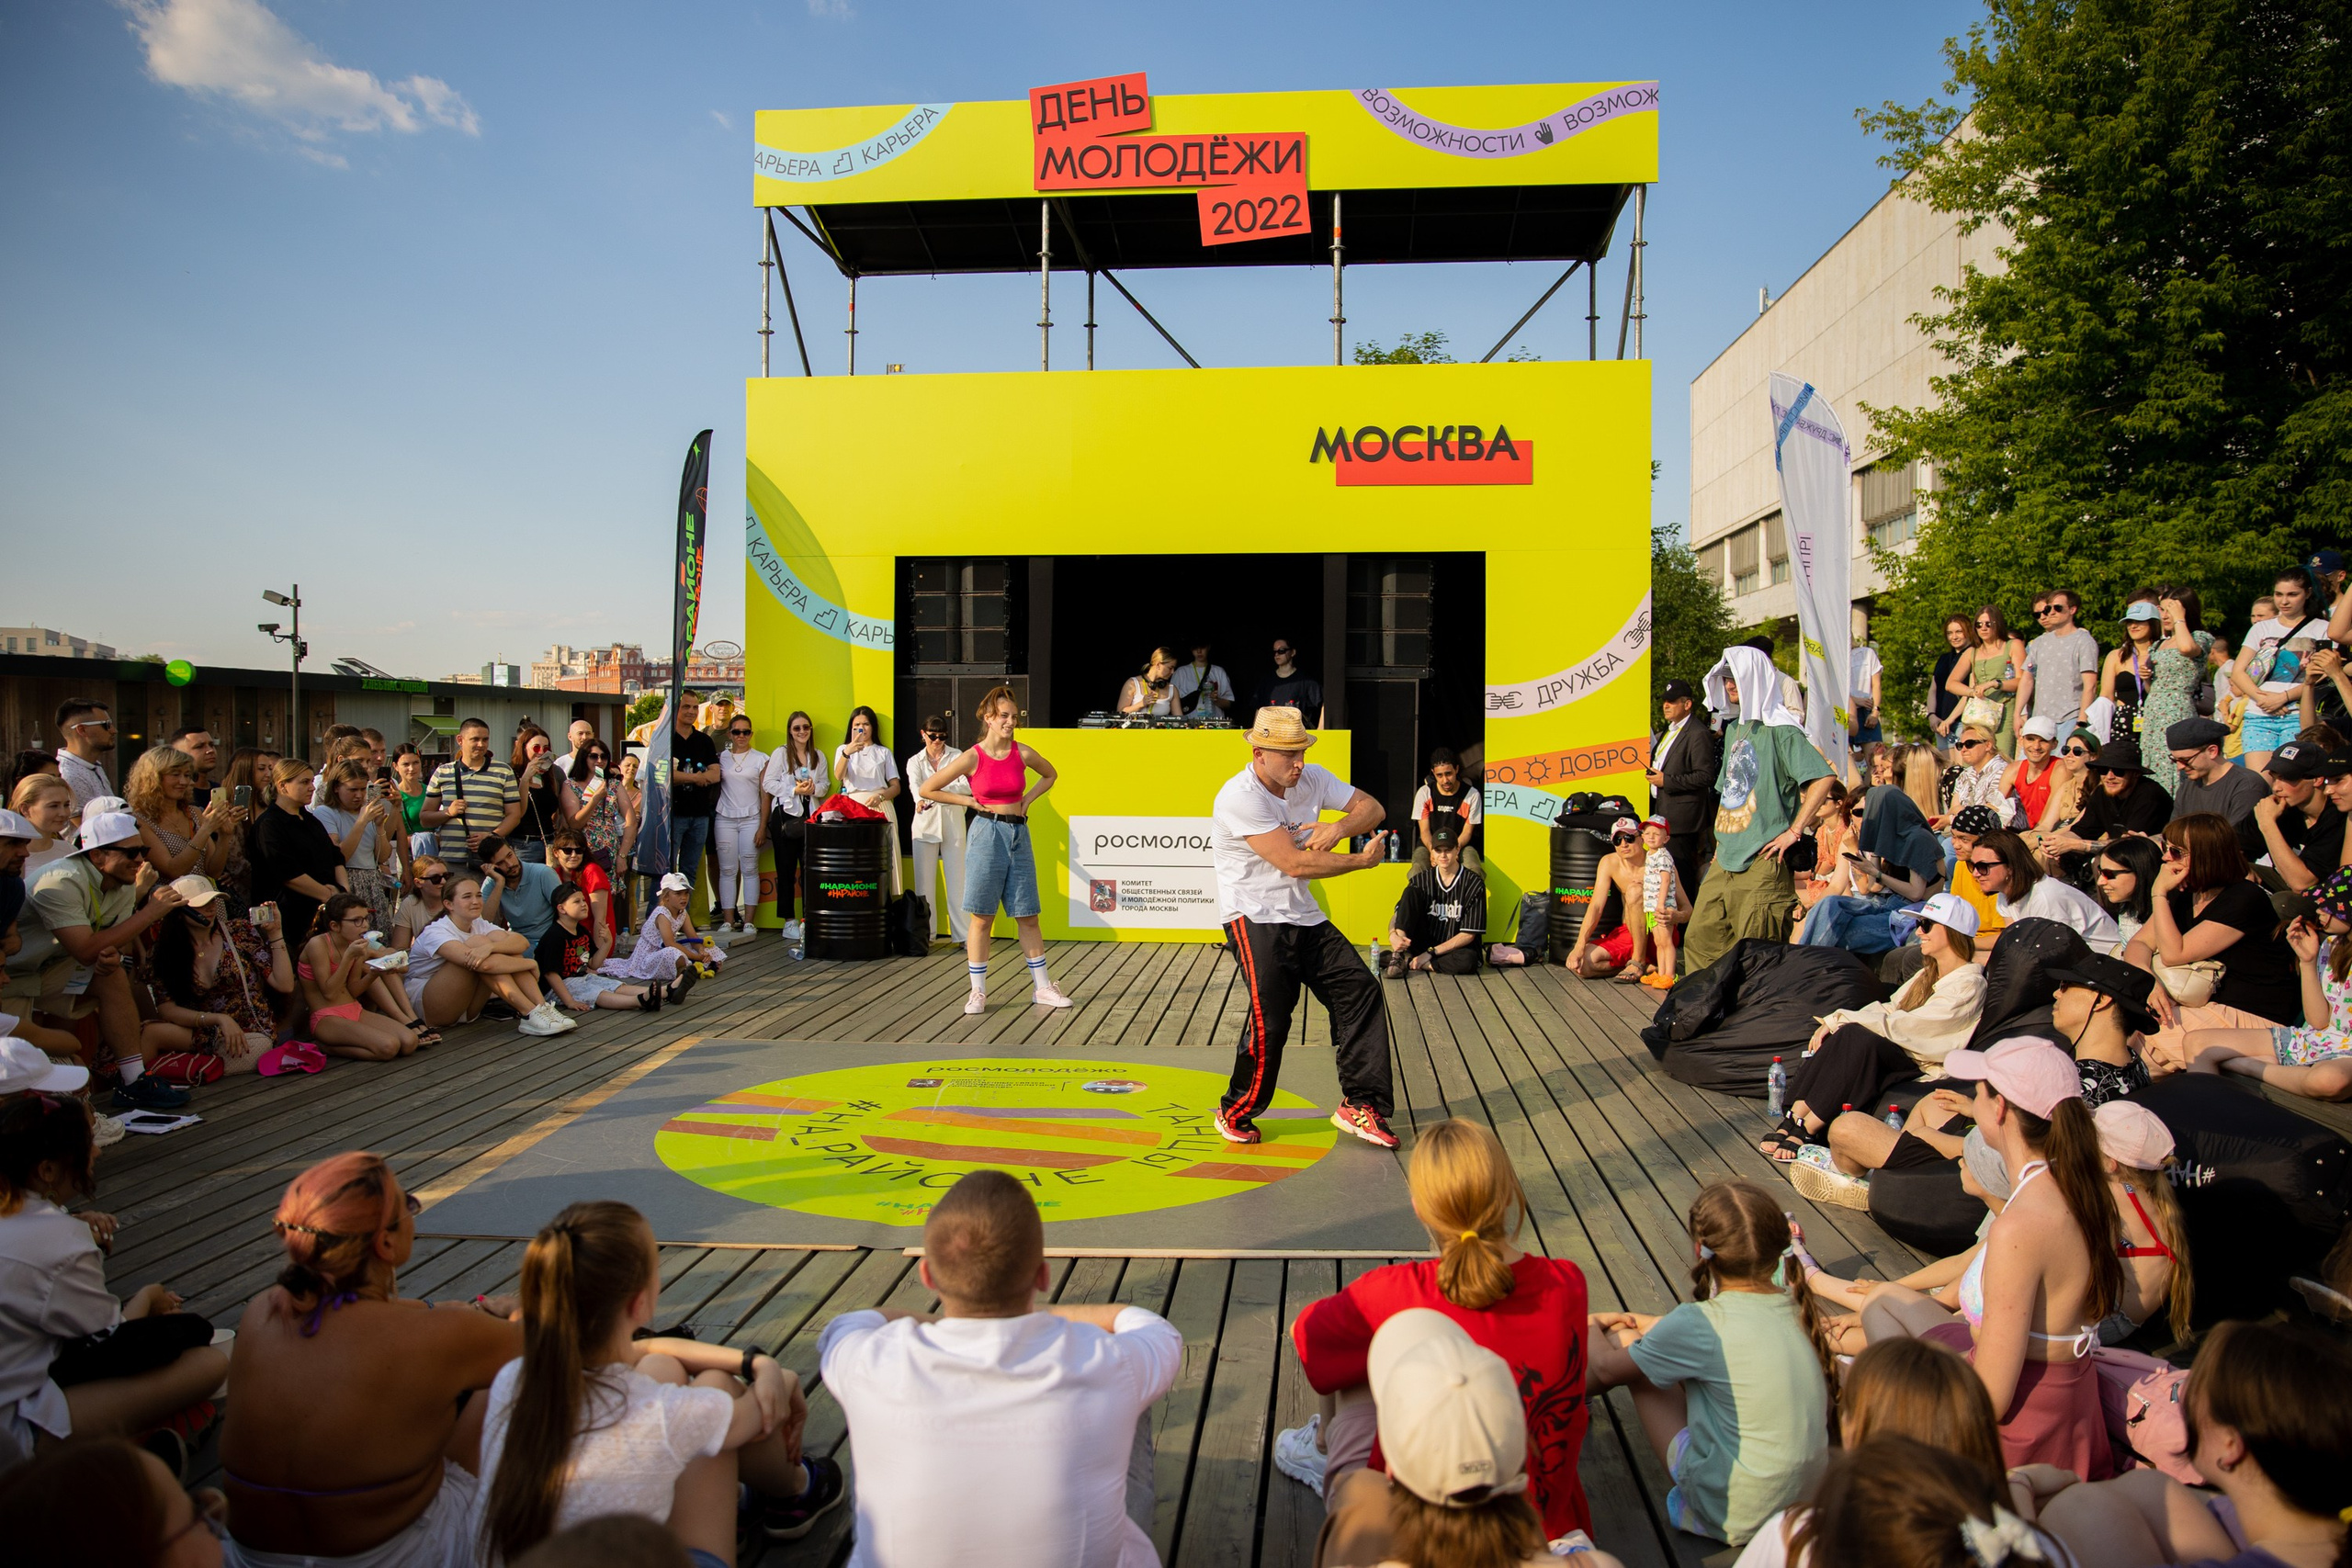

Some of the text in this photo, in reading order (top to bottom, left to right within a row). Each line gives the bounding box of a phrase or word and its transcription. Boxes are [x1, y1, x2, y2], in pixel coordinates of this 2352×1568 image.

[1036, 83, 1147, 134] ДЕНЬ
[1362, 88, 1525, 153] ВОЗМОЖНОСТИ
[1563, 87, 1658, 131] ВОЗМОЖ
[861, 106, 940, 164] КАРЬЕРА
[1040, 135, 1303, 182] МОЛОДЁЖИ
[1211, 194, 1304, 236] 2022
[1309, 424, 1520, 463] МОСКВА
[747, 537, 809, 613] КАРЬЕРА
[843, 618, 894, 645] КАРЬ
[1537, 652, 1624, 707] ДРУЖБА
[1559, 746, 1638, 778] ДОБРО
